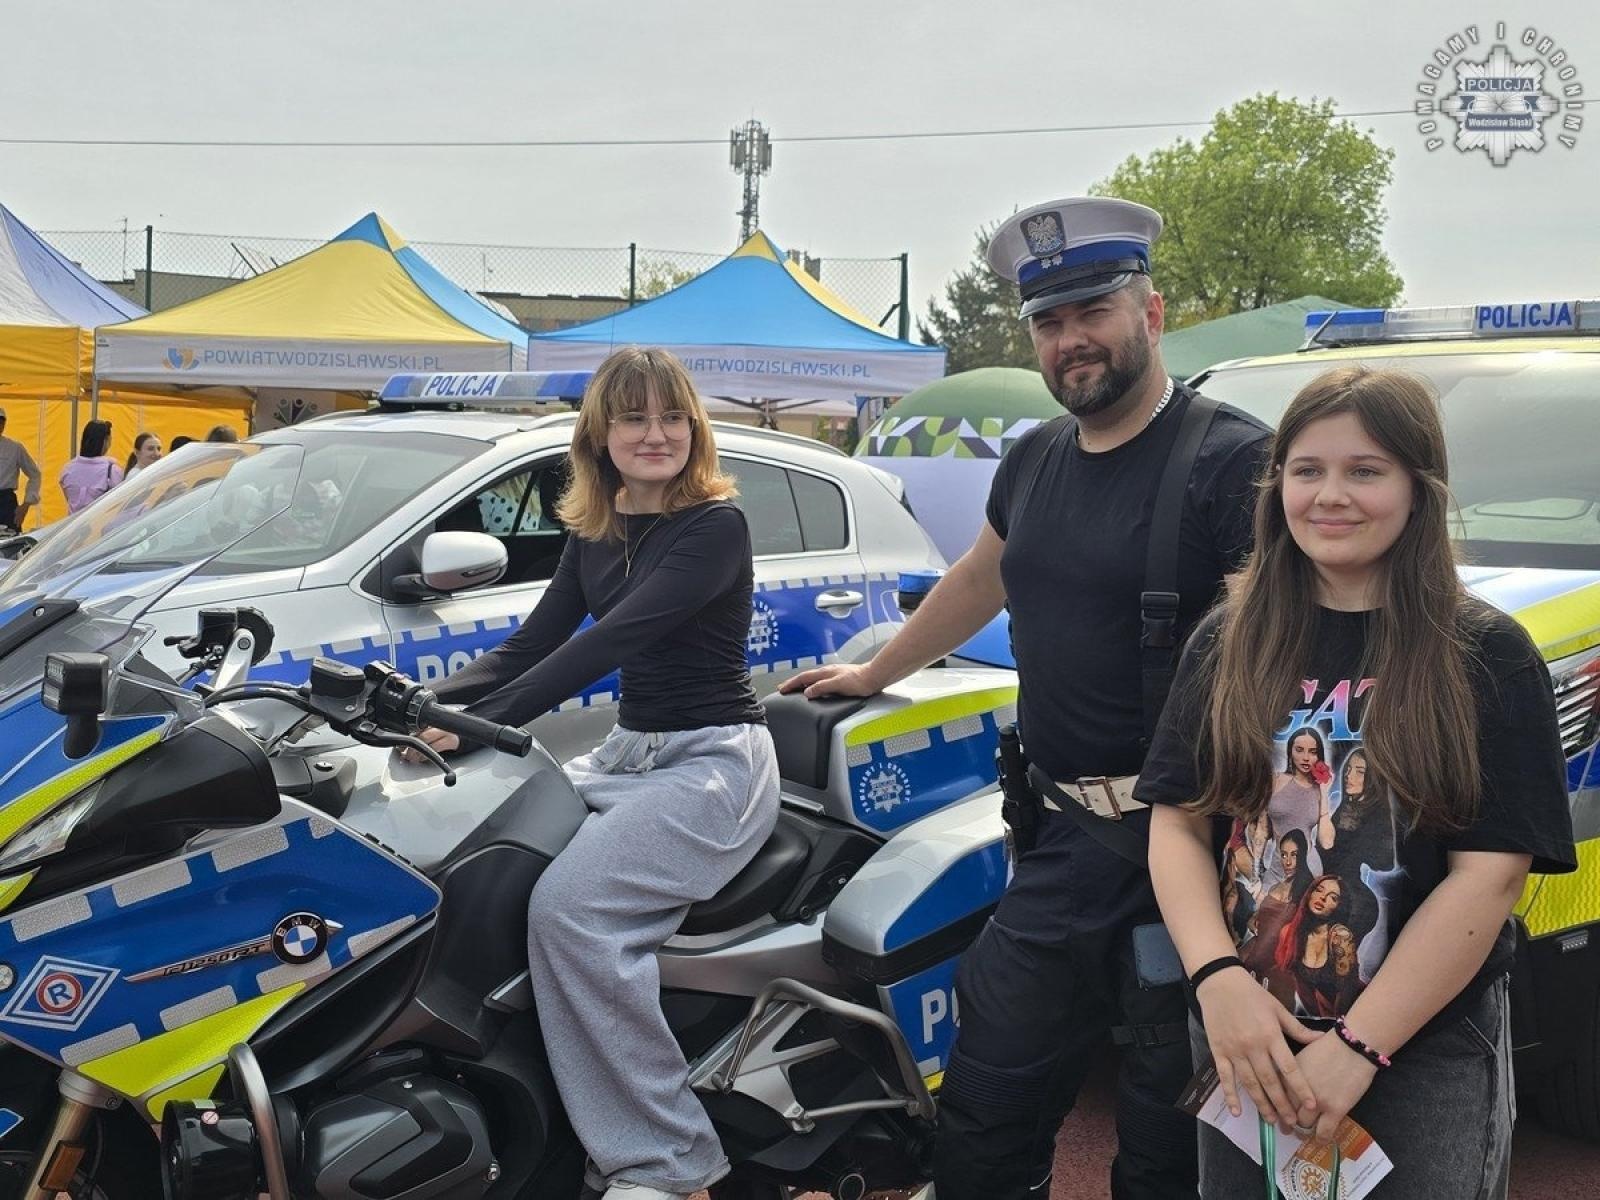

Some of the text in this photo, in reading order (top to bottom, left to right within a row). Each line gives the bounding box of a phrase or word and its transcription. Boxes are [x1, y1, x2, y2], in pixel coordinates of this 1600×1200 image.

[1478, 302, 1572, 329] POLICJA
[203, 350, 444, 370] POWIATWODZISLAWSKI.PL
[424, 374, 498, 396] POLICJA
[276, 916, 321, 937] BMW
[47, 983, 73, 1006] R
